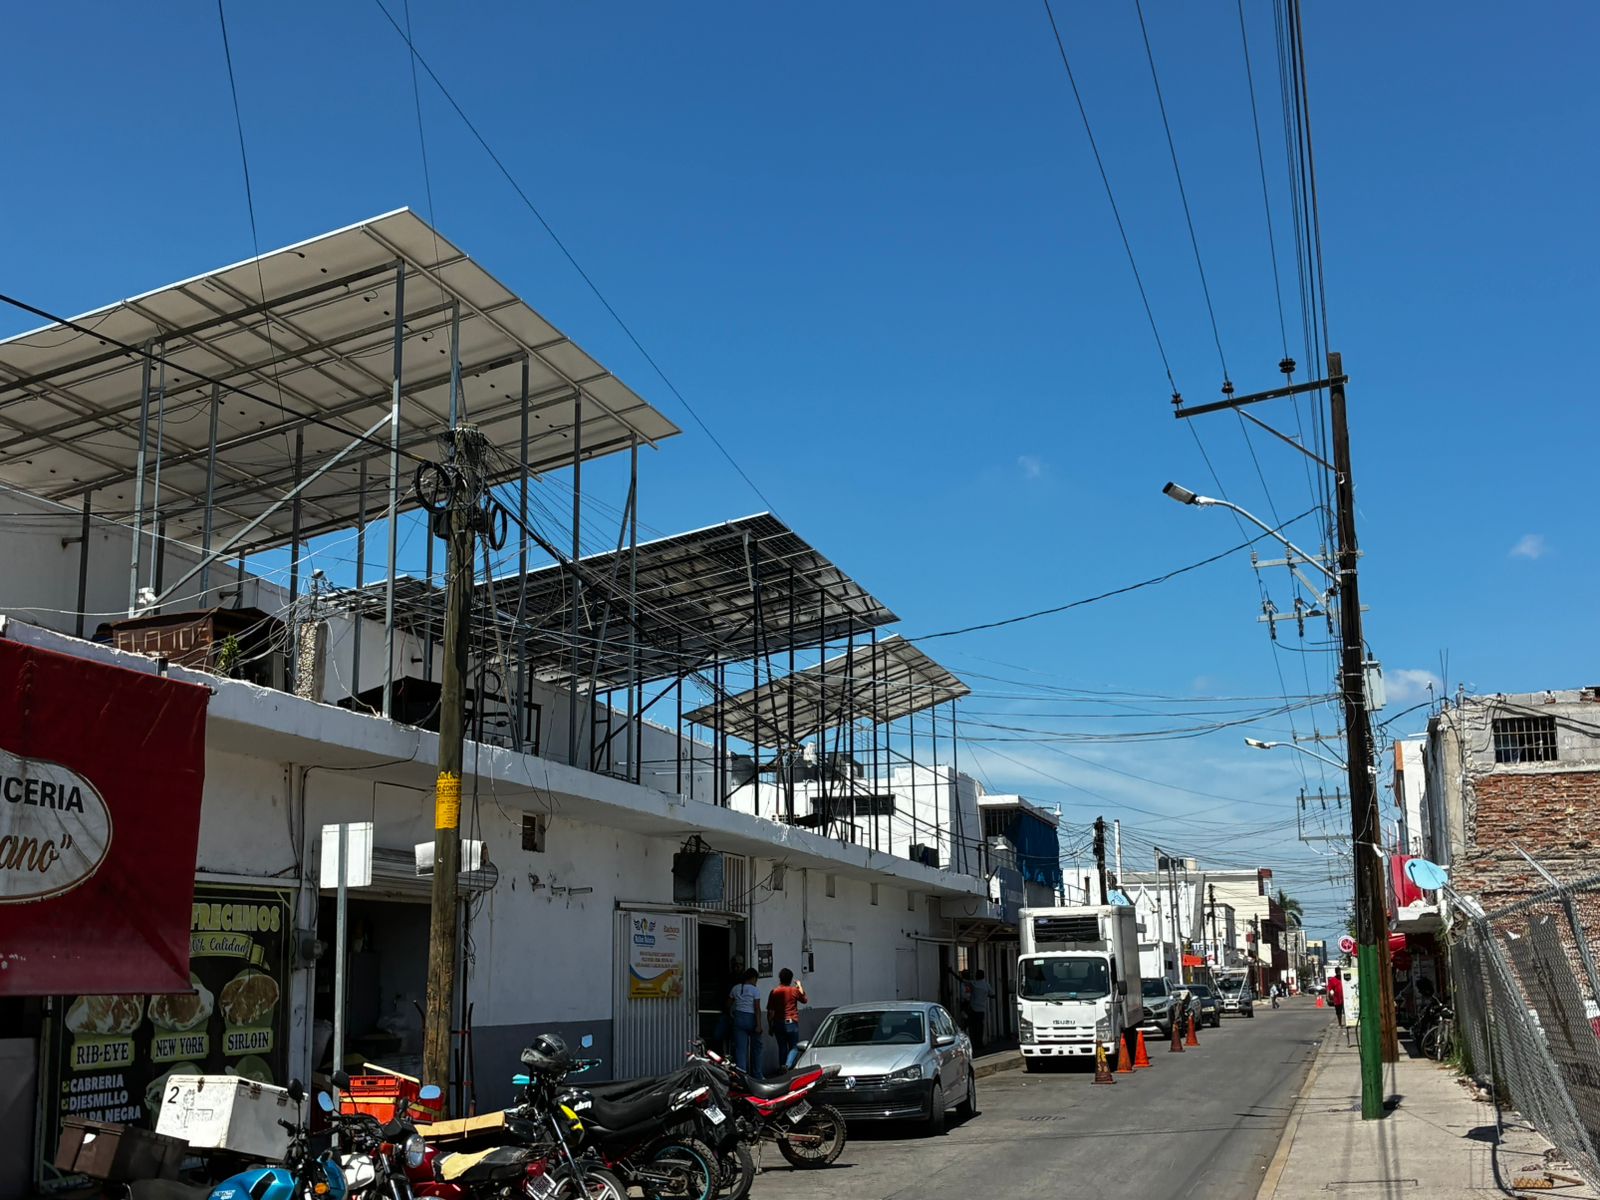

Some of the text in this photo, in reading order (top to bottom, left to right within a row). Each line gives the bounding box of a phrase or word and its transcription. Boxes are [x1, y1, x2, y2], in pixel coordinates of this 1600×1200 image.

[0, 775, 84, 813] CERIA
[156, 1036, 204, 1057] NEW YORK
[228, 1031, 269, 1051] SIRLOIN
[76, 1042, 129, 1065] RIB-EYE
[70, 1074, 124, 1093] CABRERIA
[167, 1086, 180, 1104] 2
[105, 1105, 142, 1123] NEGRA
